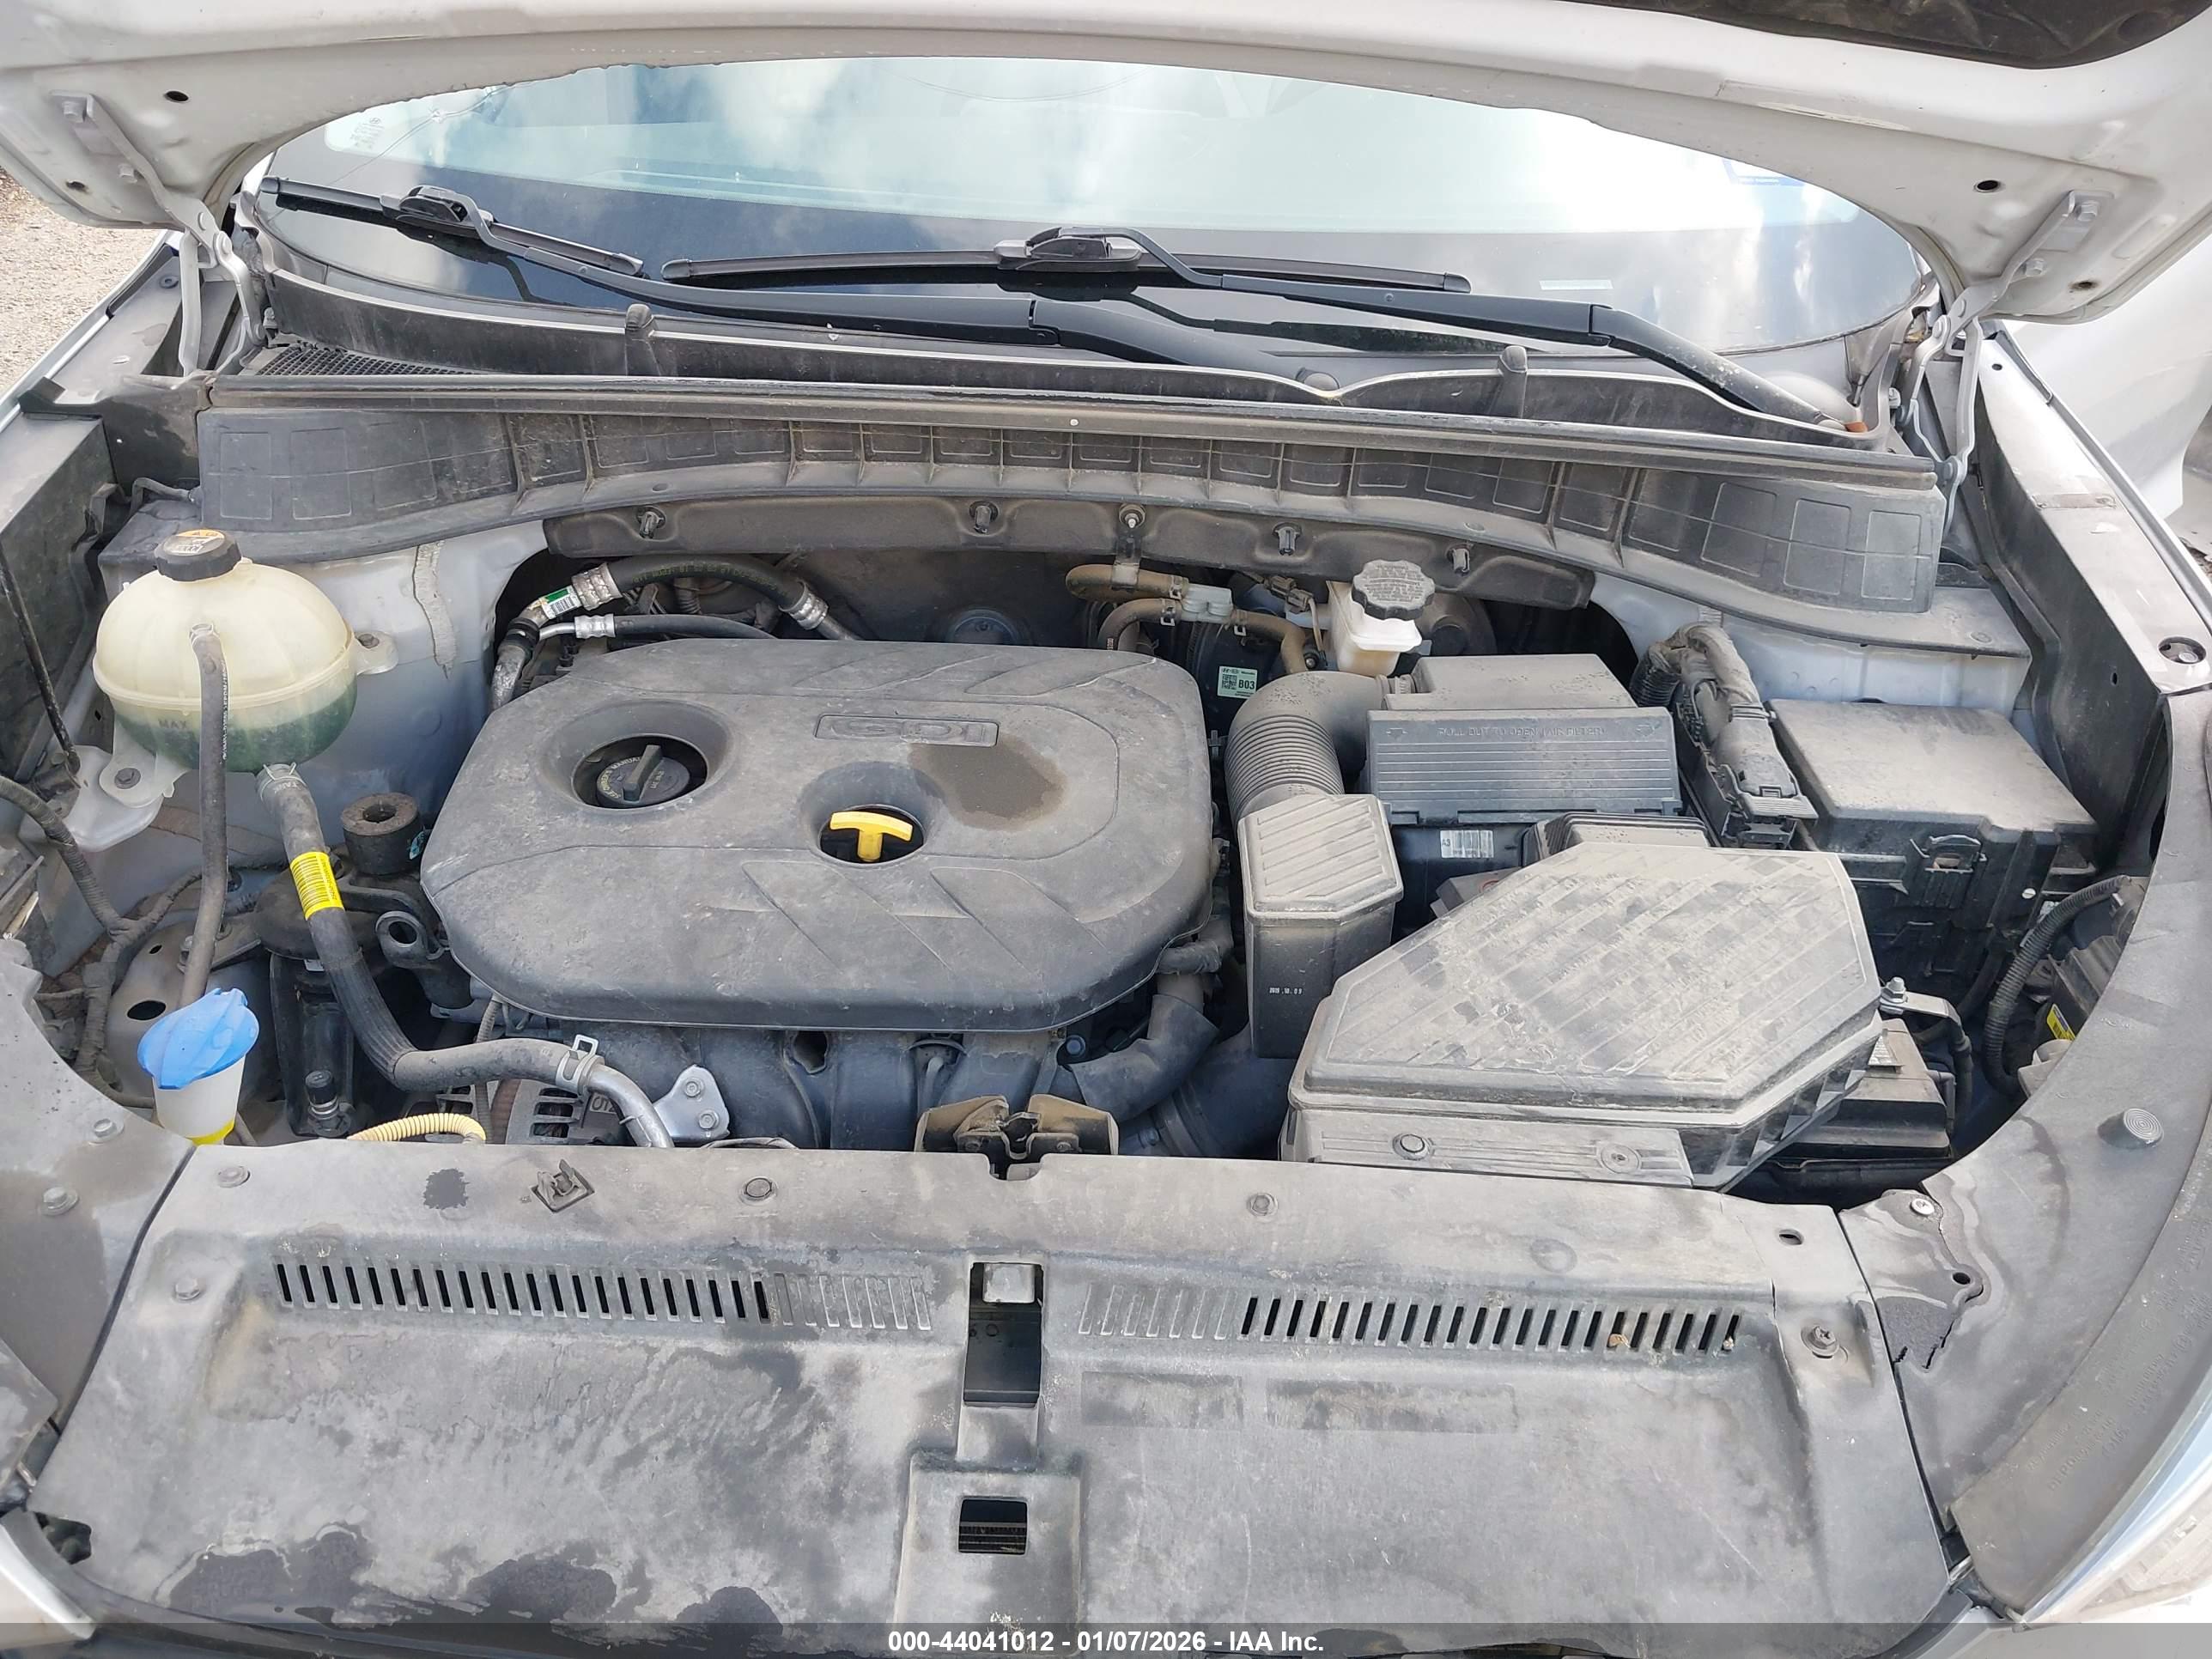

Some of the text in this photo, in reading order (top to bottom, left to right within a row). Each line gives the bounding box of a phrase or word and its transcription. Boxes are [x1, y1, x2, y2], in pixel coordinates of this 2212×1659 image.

[1238, 679, 1255, 690] B03
[158, 718, 187, 729] MAX
[831, 719, 986, 743] GDI
[1437, 726, 1464, 737] PULL
[1468, 726, 1489, 737] OUT
[1510, 726, 1538, 737] OPEN
